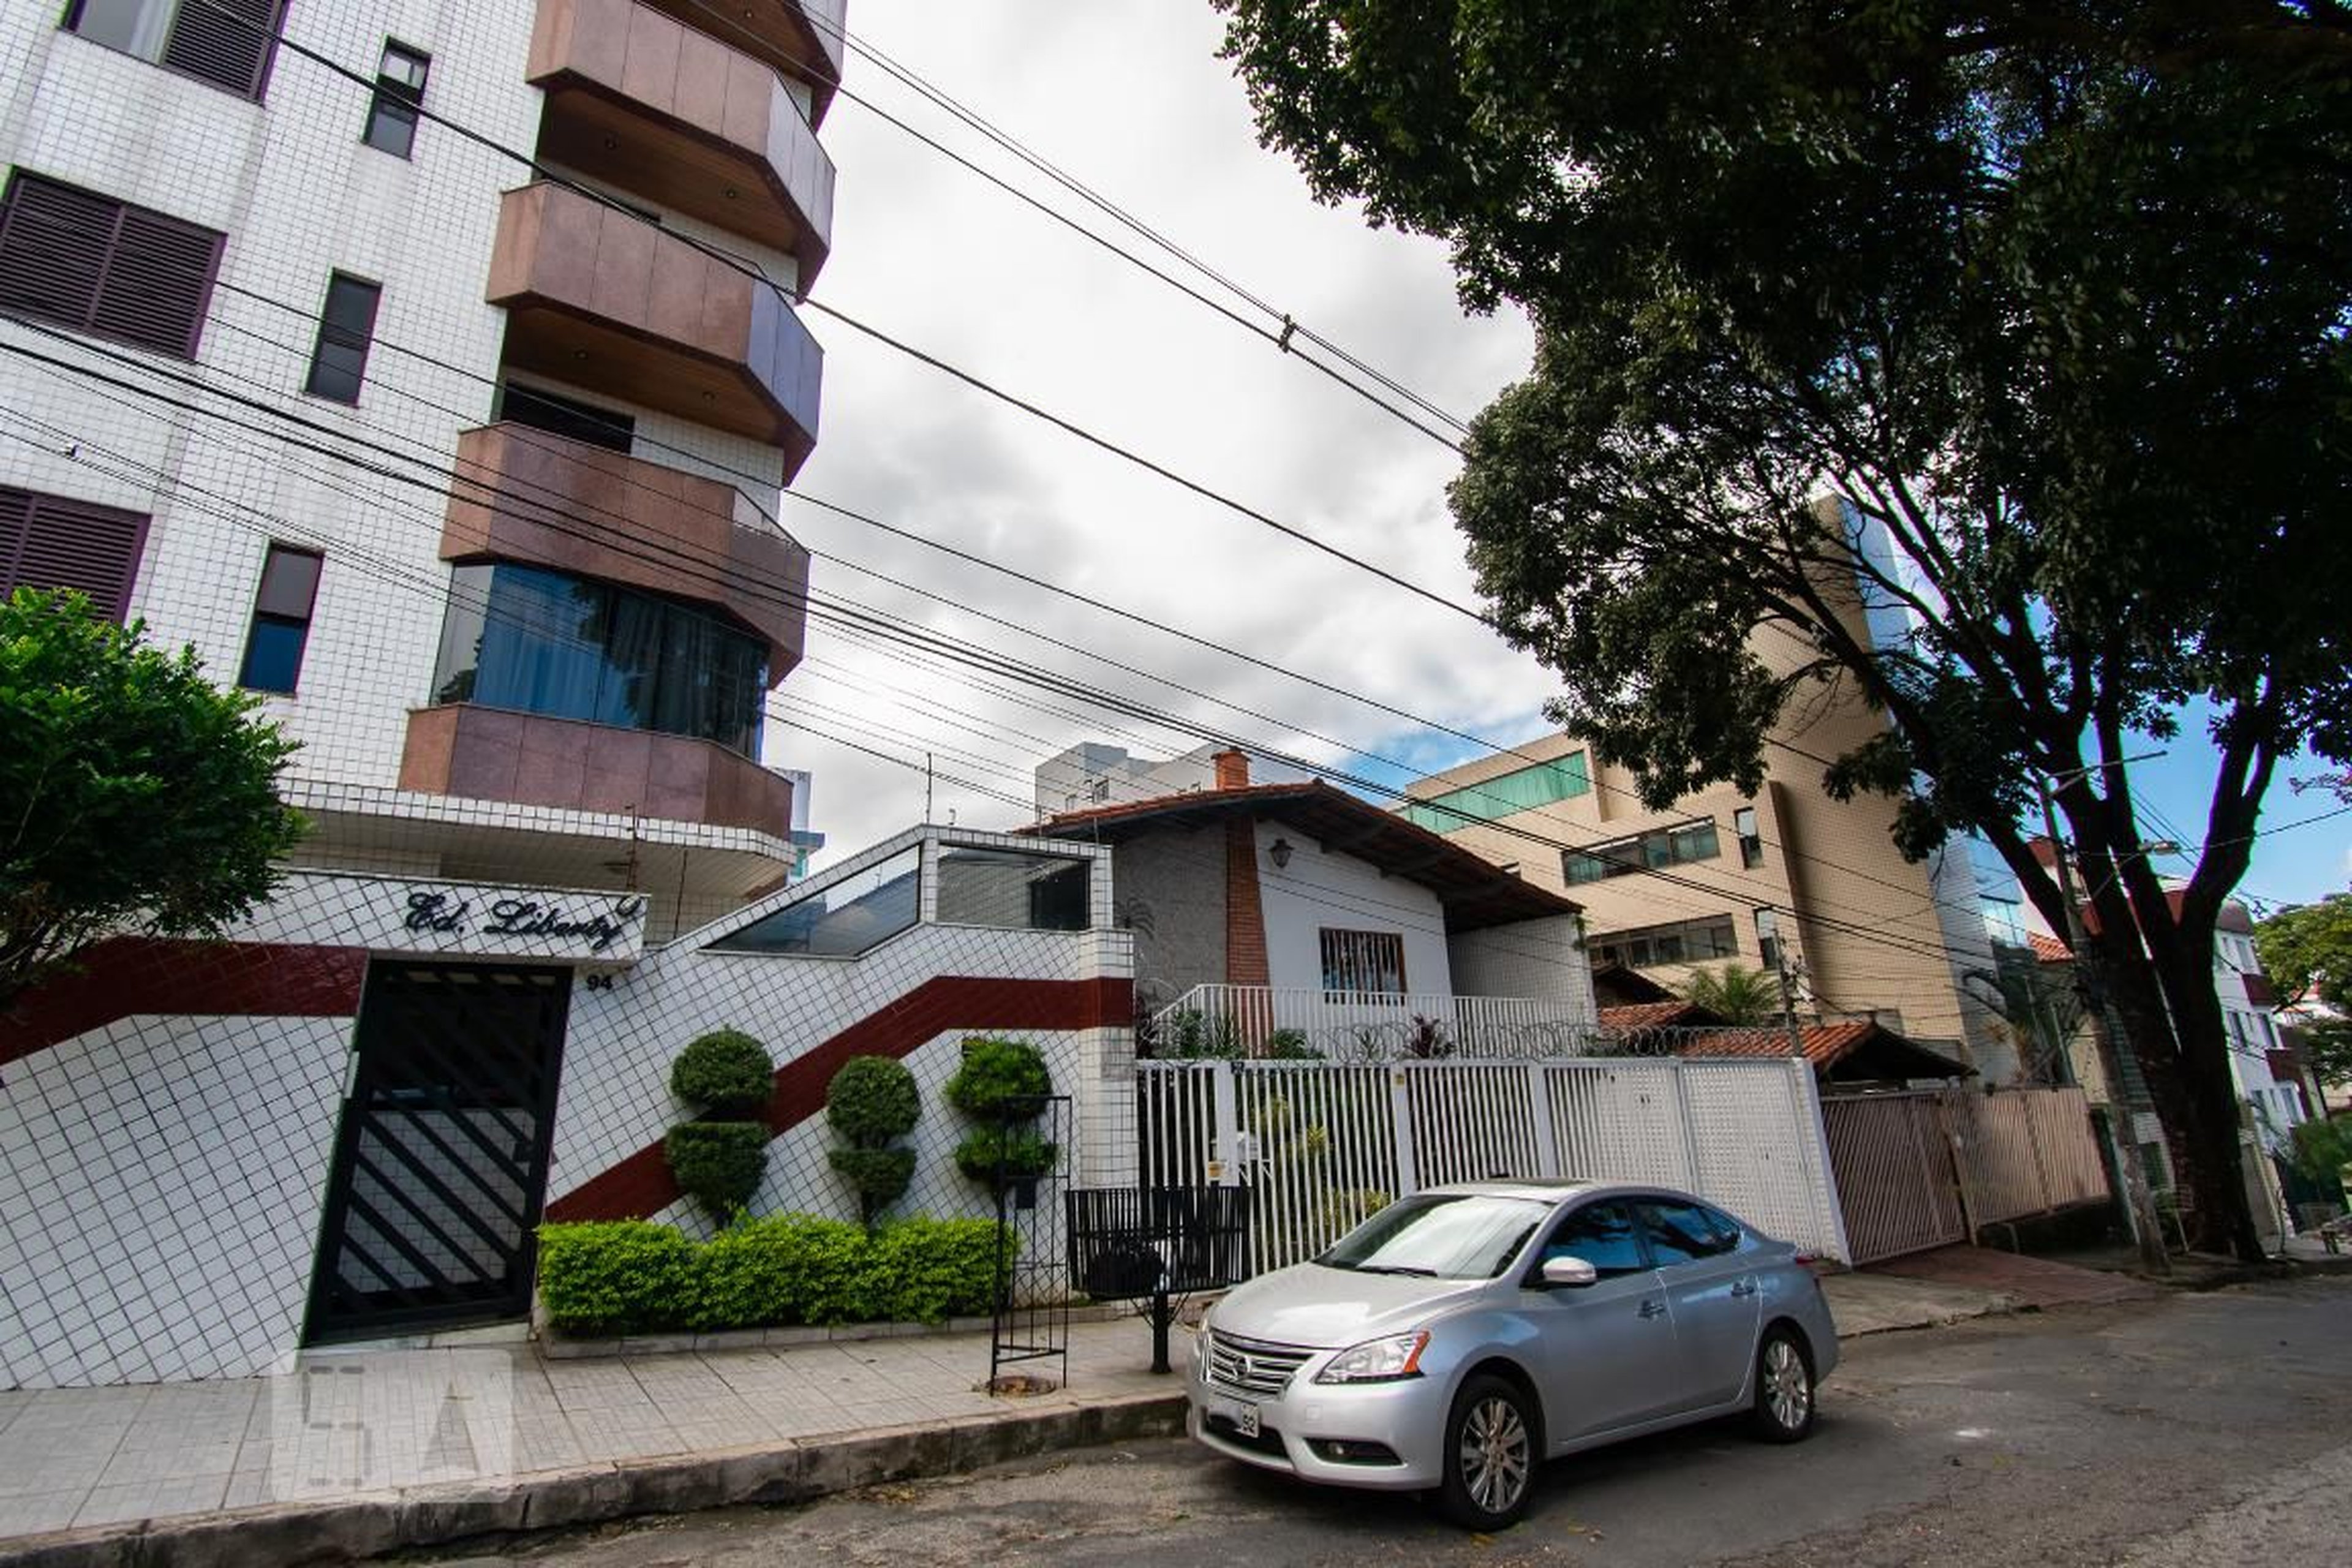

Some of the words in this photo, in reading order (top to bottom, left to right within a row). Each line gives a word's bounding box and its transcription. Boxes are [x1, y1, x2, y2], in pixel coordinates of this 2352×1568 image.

[406, 892, 470, 933] Ed.
[483, 899, 622, 950] Liberty
[586, 974, 613, 991] 94
